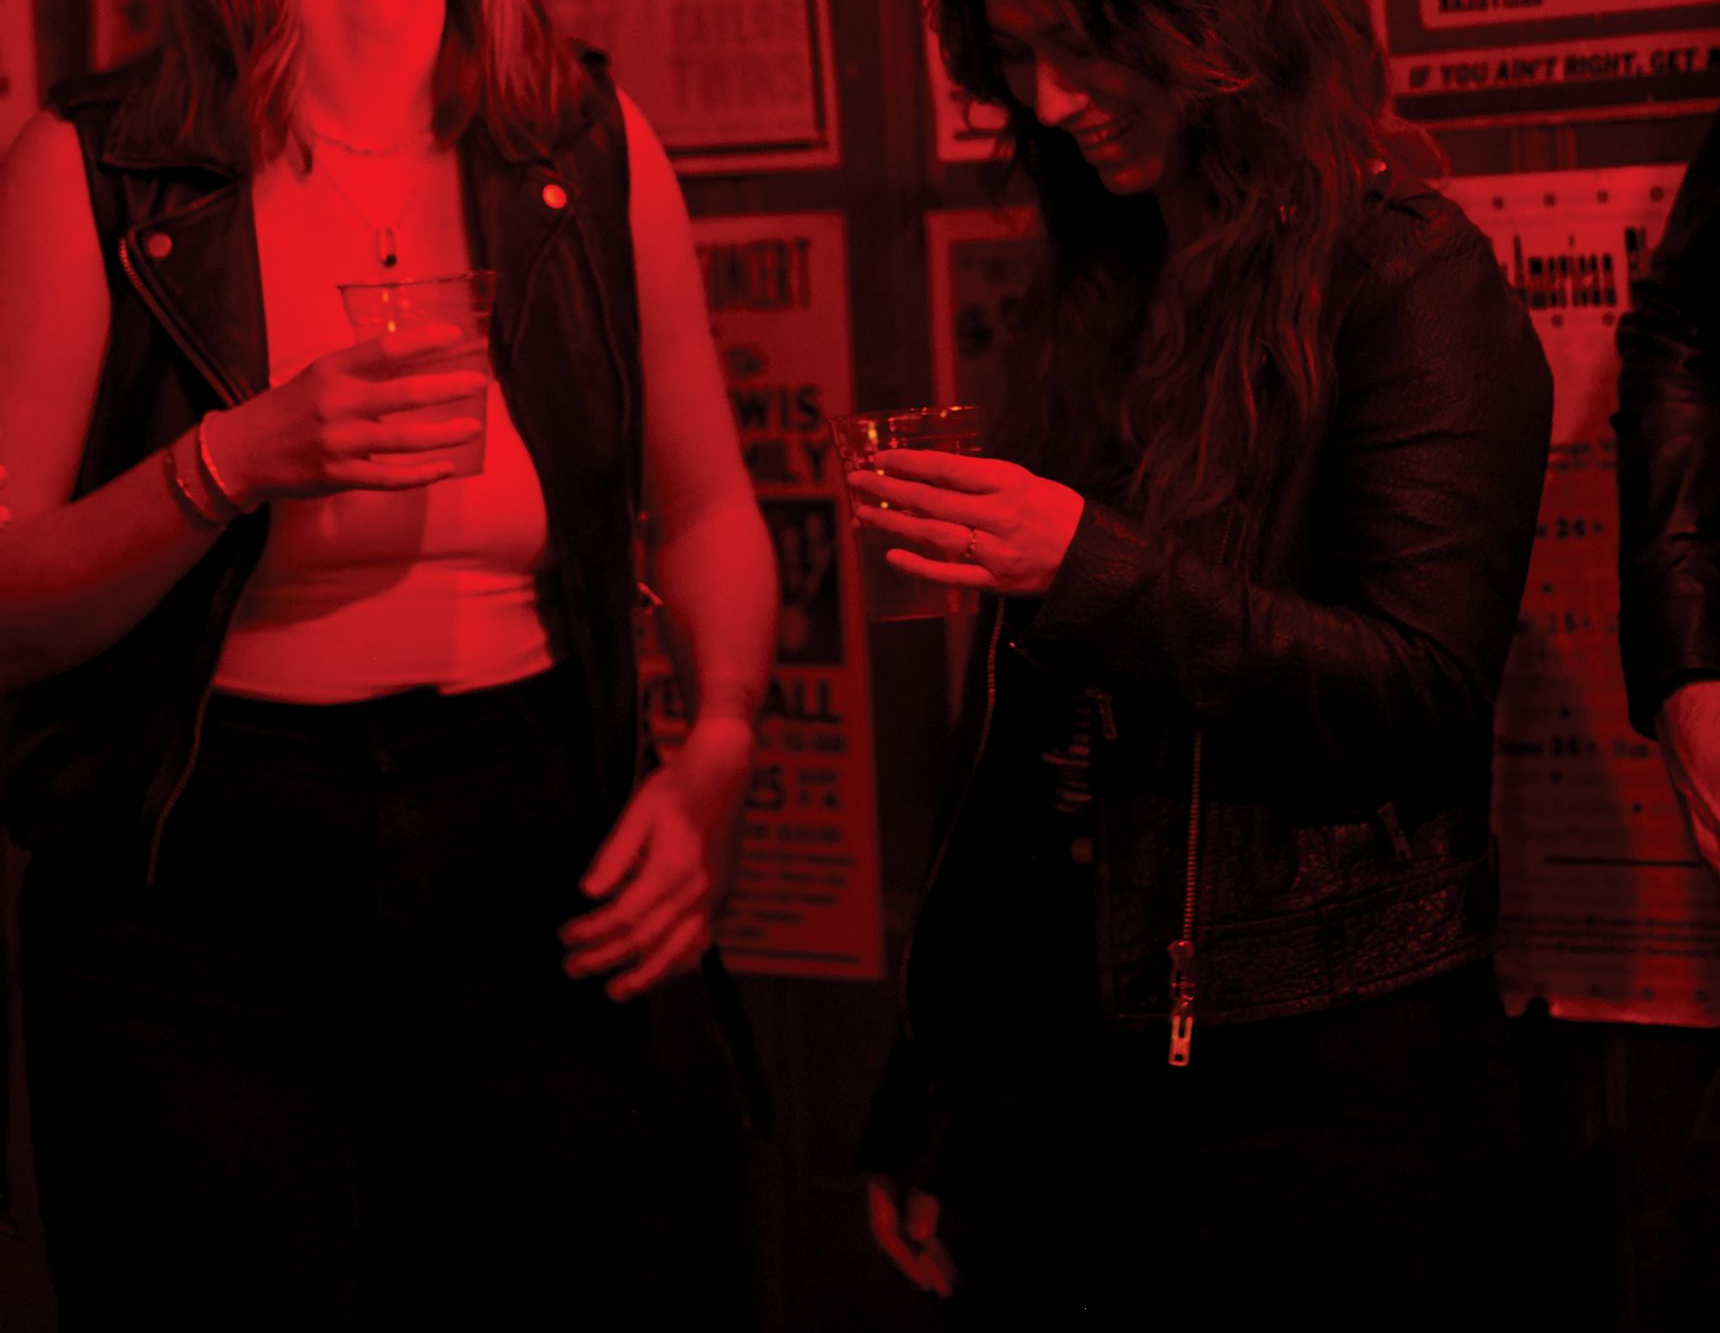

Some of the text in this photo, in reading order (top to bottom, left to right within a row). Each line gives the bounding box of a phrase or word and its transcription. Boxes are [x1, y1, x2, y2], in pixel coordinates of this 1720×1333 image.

[1440, 61, 1490, 86] YOU
[1650, 47, 1699, 74] GET
[731, 384, 821, 432] WIS
